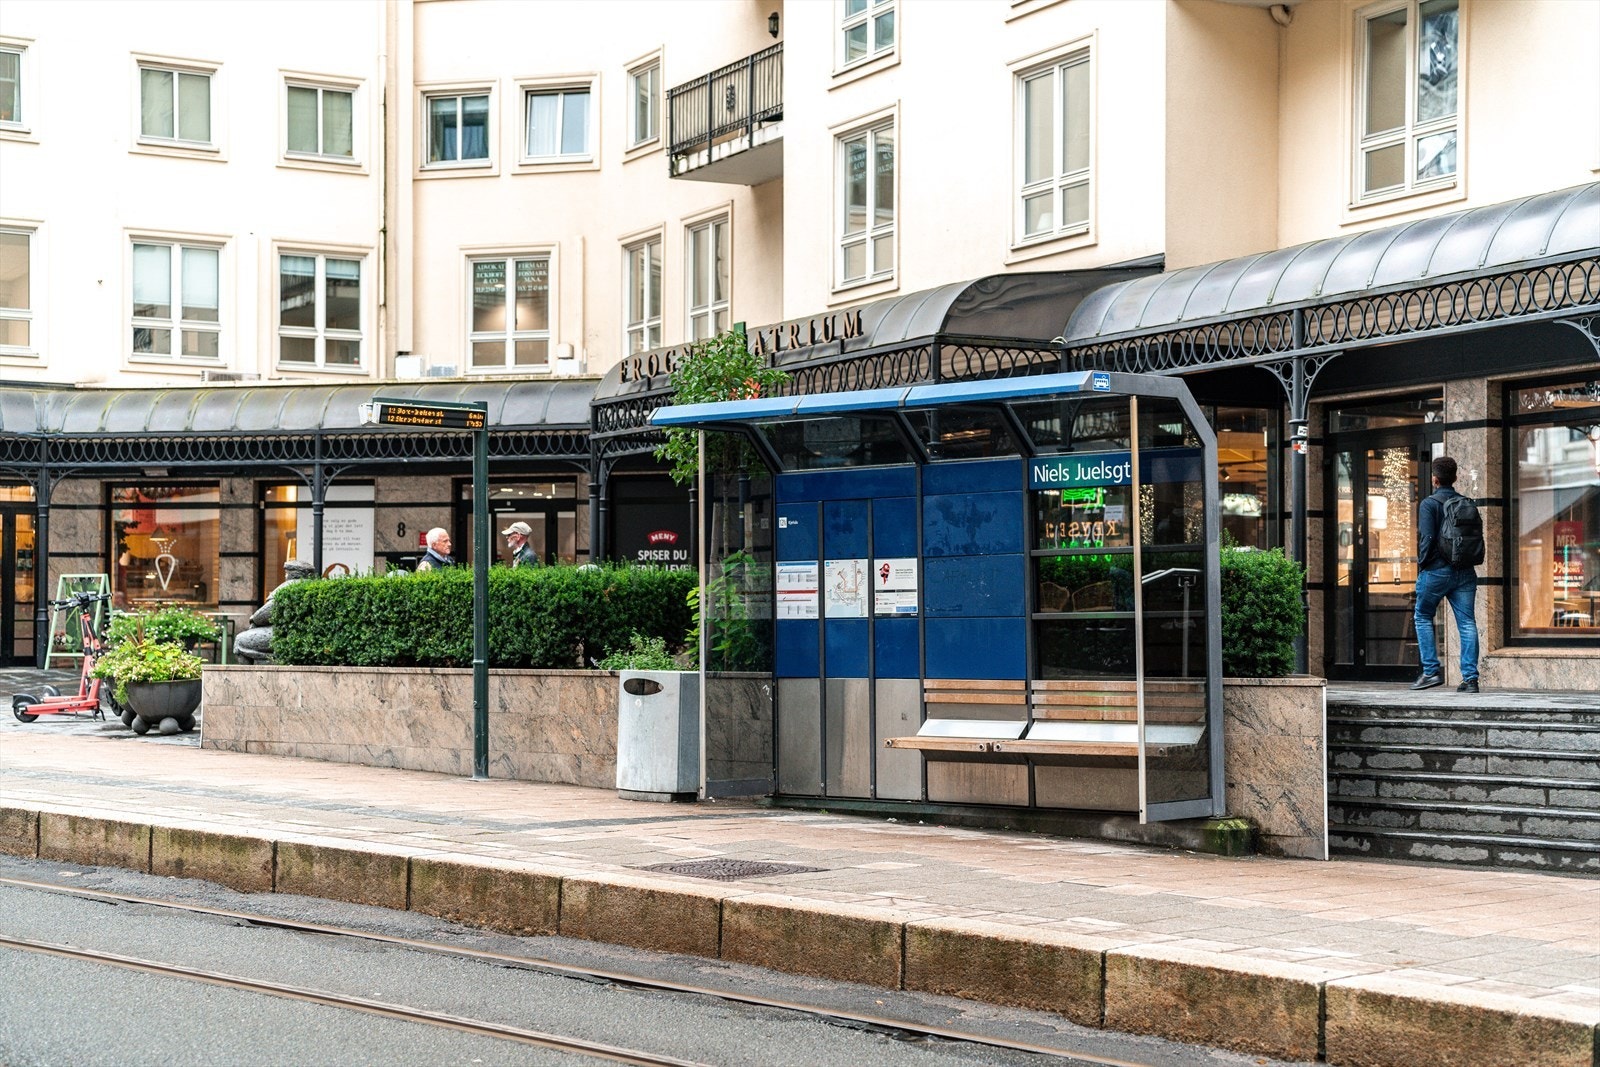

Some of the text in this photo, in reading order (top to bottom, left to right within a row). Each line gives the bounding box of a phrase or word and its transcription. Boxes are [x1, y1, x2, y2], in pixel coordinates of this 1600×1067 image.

[618, 309, 864, 384] FROGN ATRIUM
[1034, 460, 1131, 484] Niels Juelsgt
[397, 521, 406, 538] 8
[650, 532, 676, 542] MENY
[638, 549, 688, 561] SPISER DU
